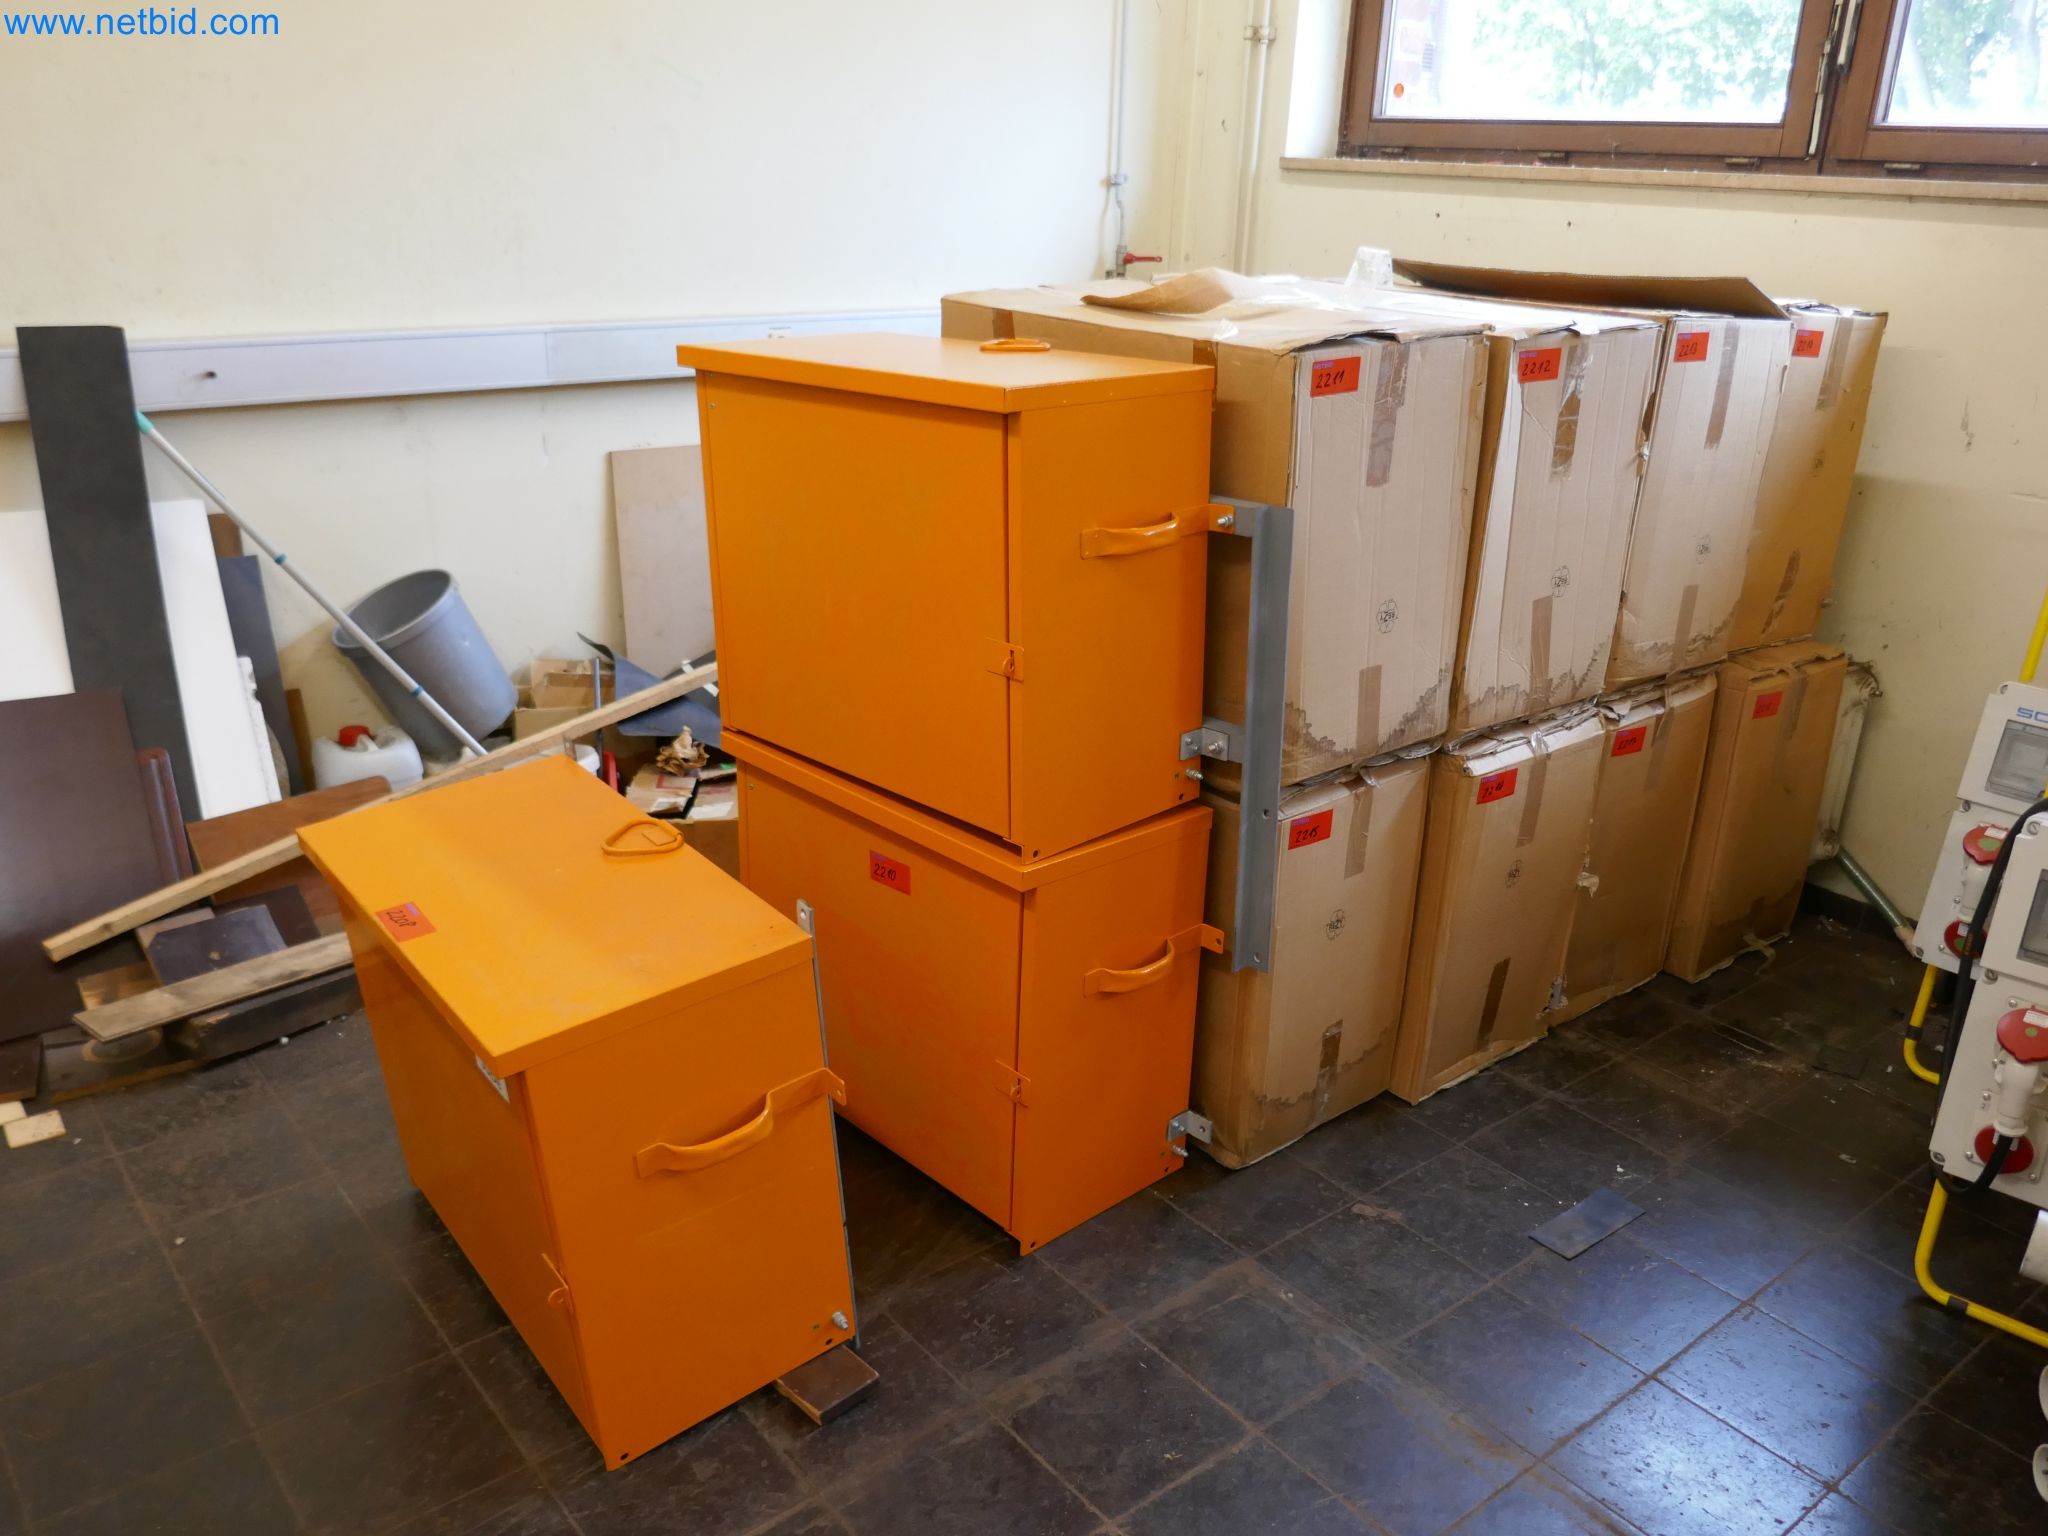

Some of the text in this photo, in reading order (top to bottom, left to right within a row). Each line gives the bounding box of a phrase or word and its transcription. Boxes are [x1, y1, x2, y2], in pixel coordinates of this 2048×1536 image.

[1521, 359, 1551, 377] 2212
[1316, 370, 1345, 389] 2211
[1295, 824, 1320, 843] 2215
[873, 863, 897, 881] 2210
